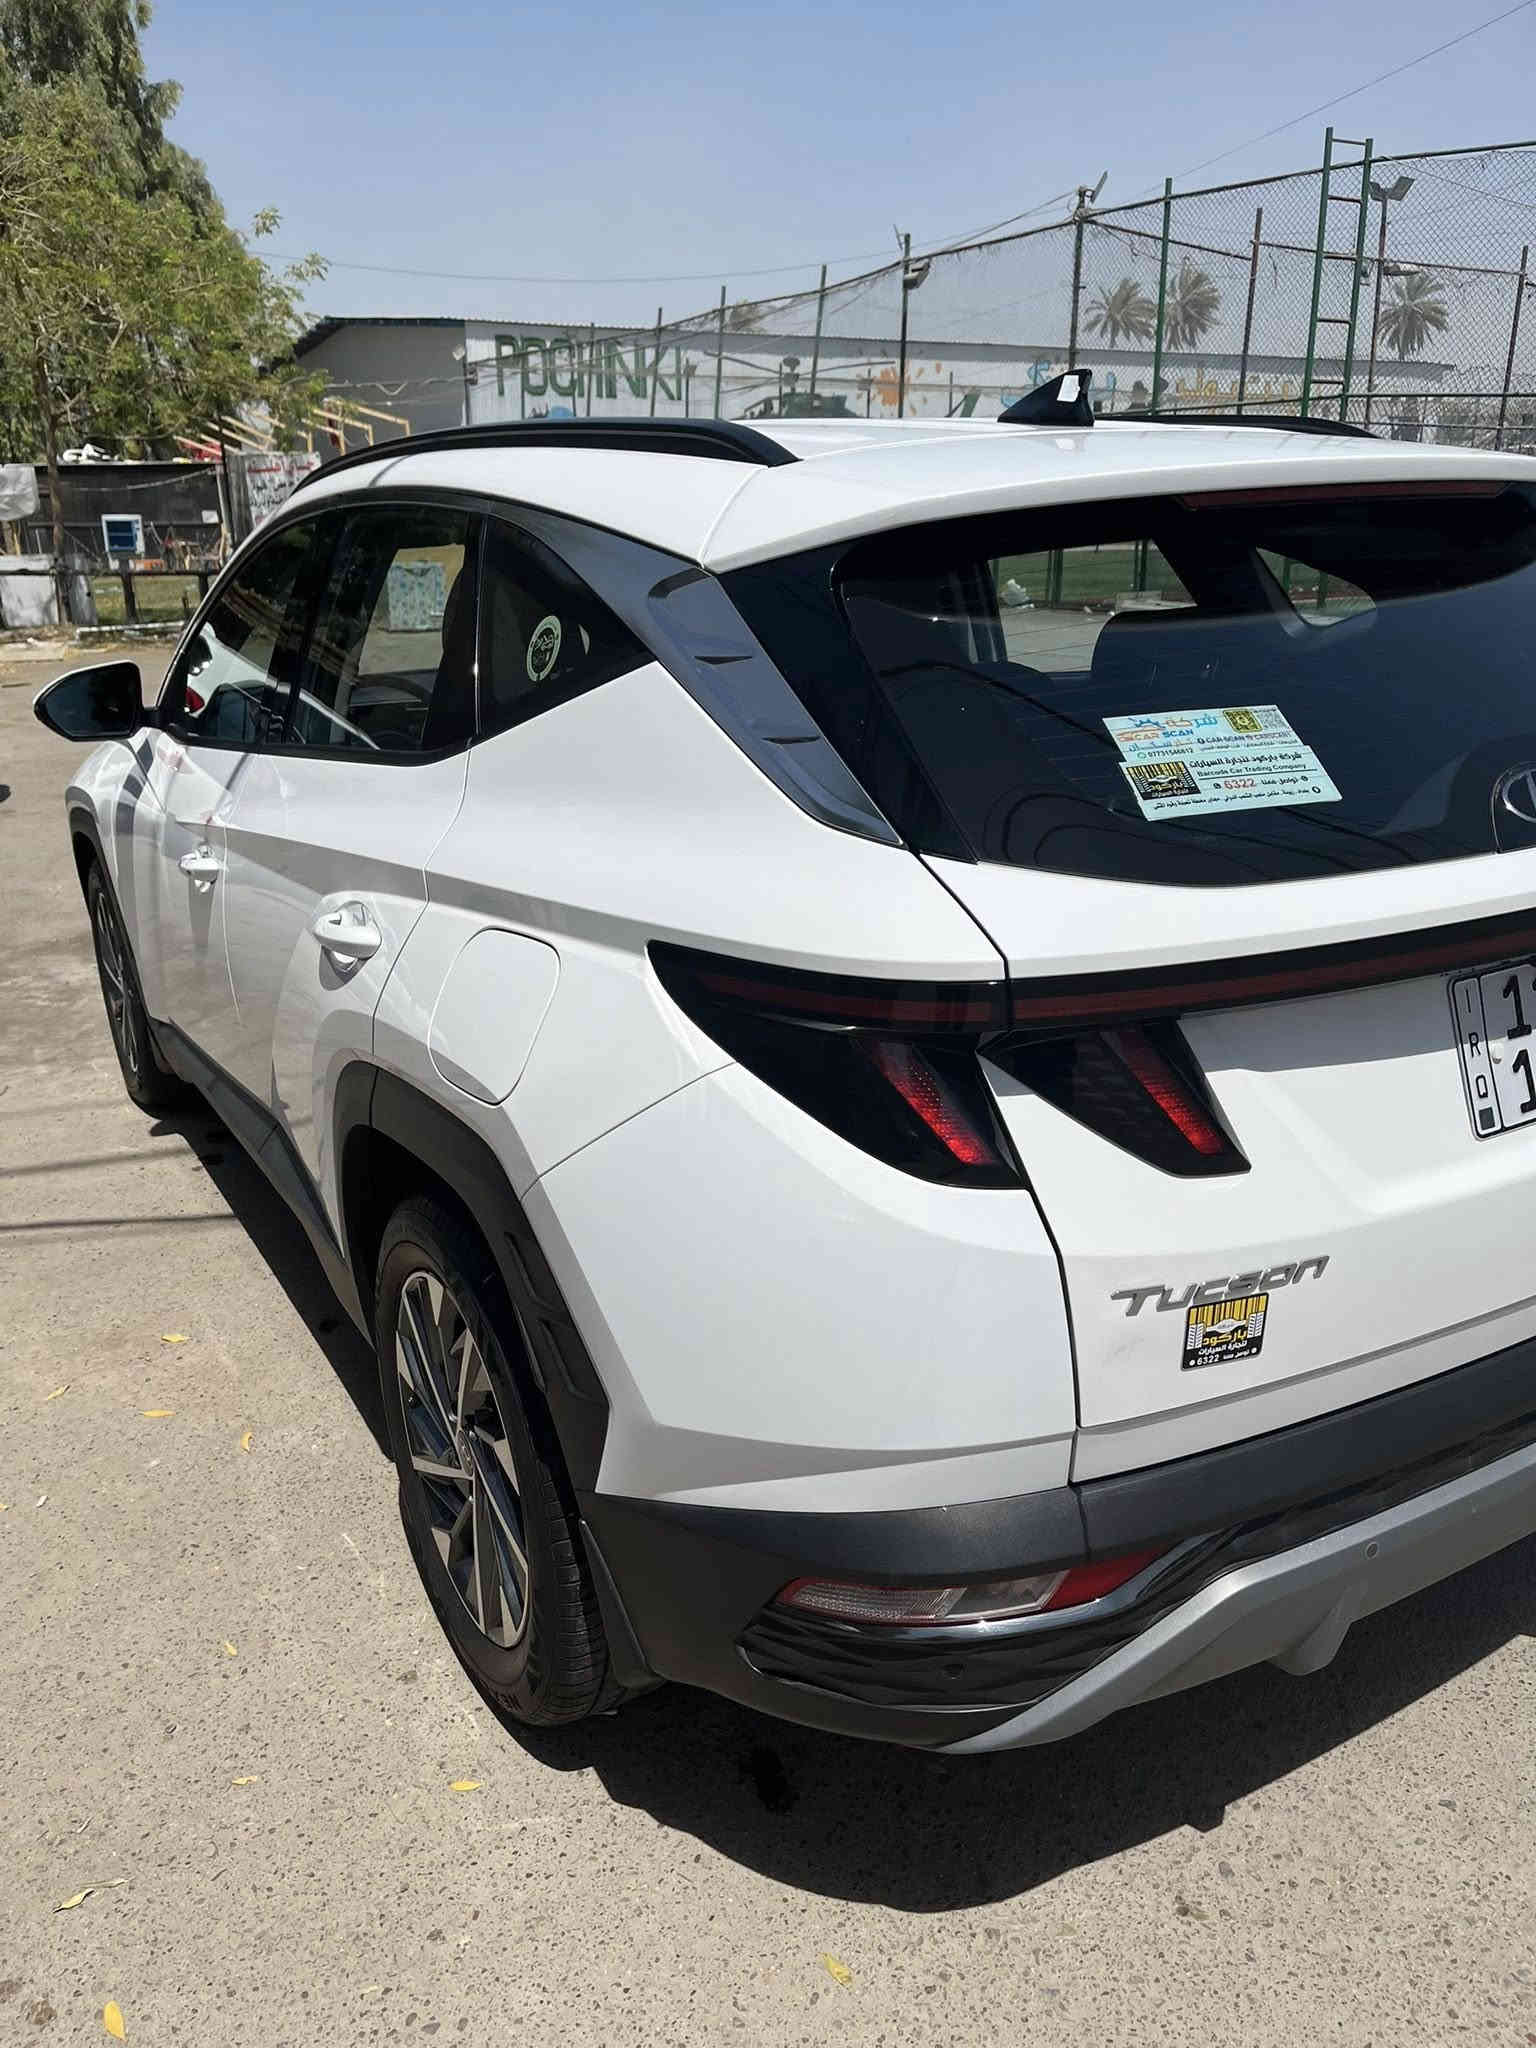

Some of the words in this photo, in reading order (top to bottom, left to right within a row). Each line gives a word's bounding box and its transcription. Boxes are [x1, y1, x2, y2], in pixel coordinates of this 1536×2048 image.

[495, 334, 682, 401] POCHINKI
[1162, 729, 1194, 738] SCAN
[1225, 756, 1251, 766] لتجارة
[1252, 754, 1279, 764] باركود
[1279, 752, 1303, 761] شركة
[1189, 758, 1224, 768] السيارات
[1197, 769, 1229, 777] Barcode
[1244, 765, 1272, 773] Trading
[1272, 763, 1306, 771] Company
[1224, 778, 1257, 790] 6322
[1465, 988, 1489, 1098] IRQ
[1110, 1256, 1330, 1317] TUCSON
[1203, 1328, 1248, 1346] باركود
[1198, 1344, 1227, 1356] السيارات
[1196, 1354, 1220, 1366] 6322
